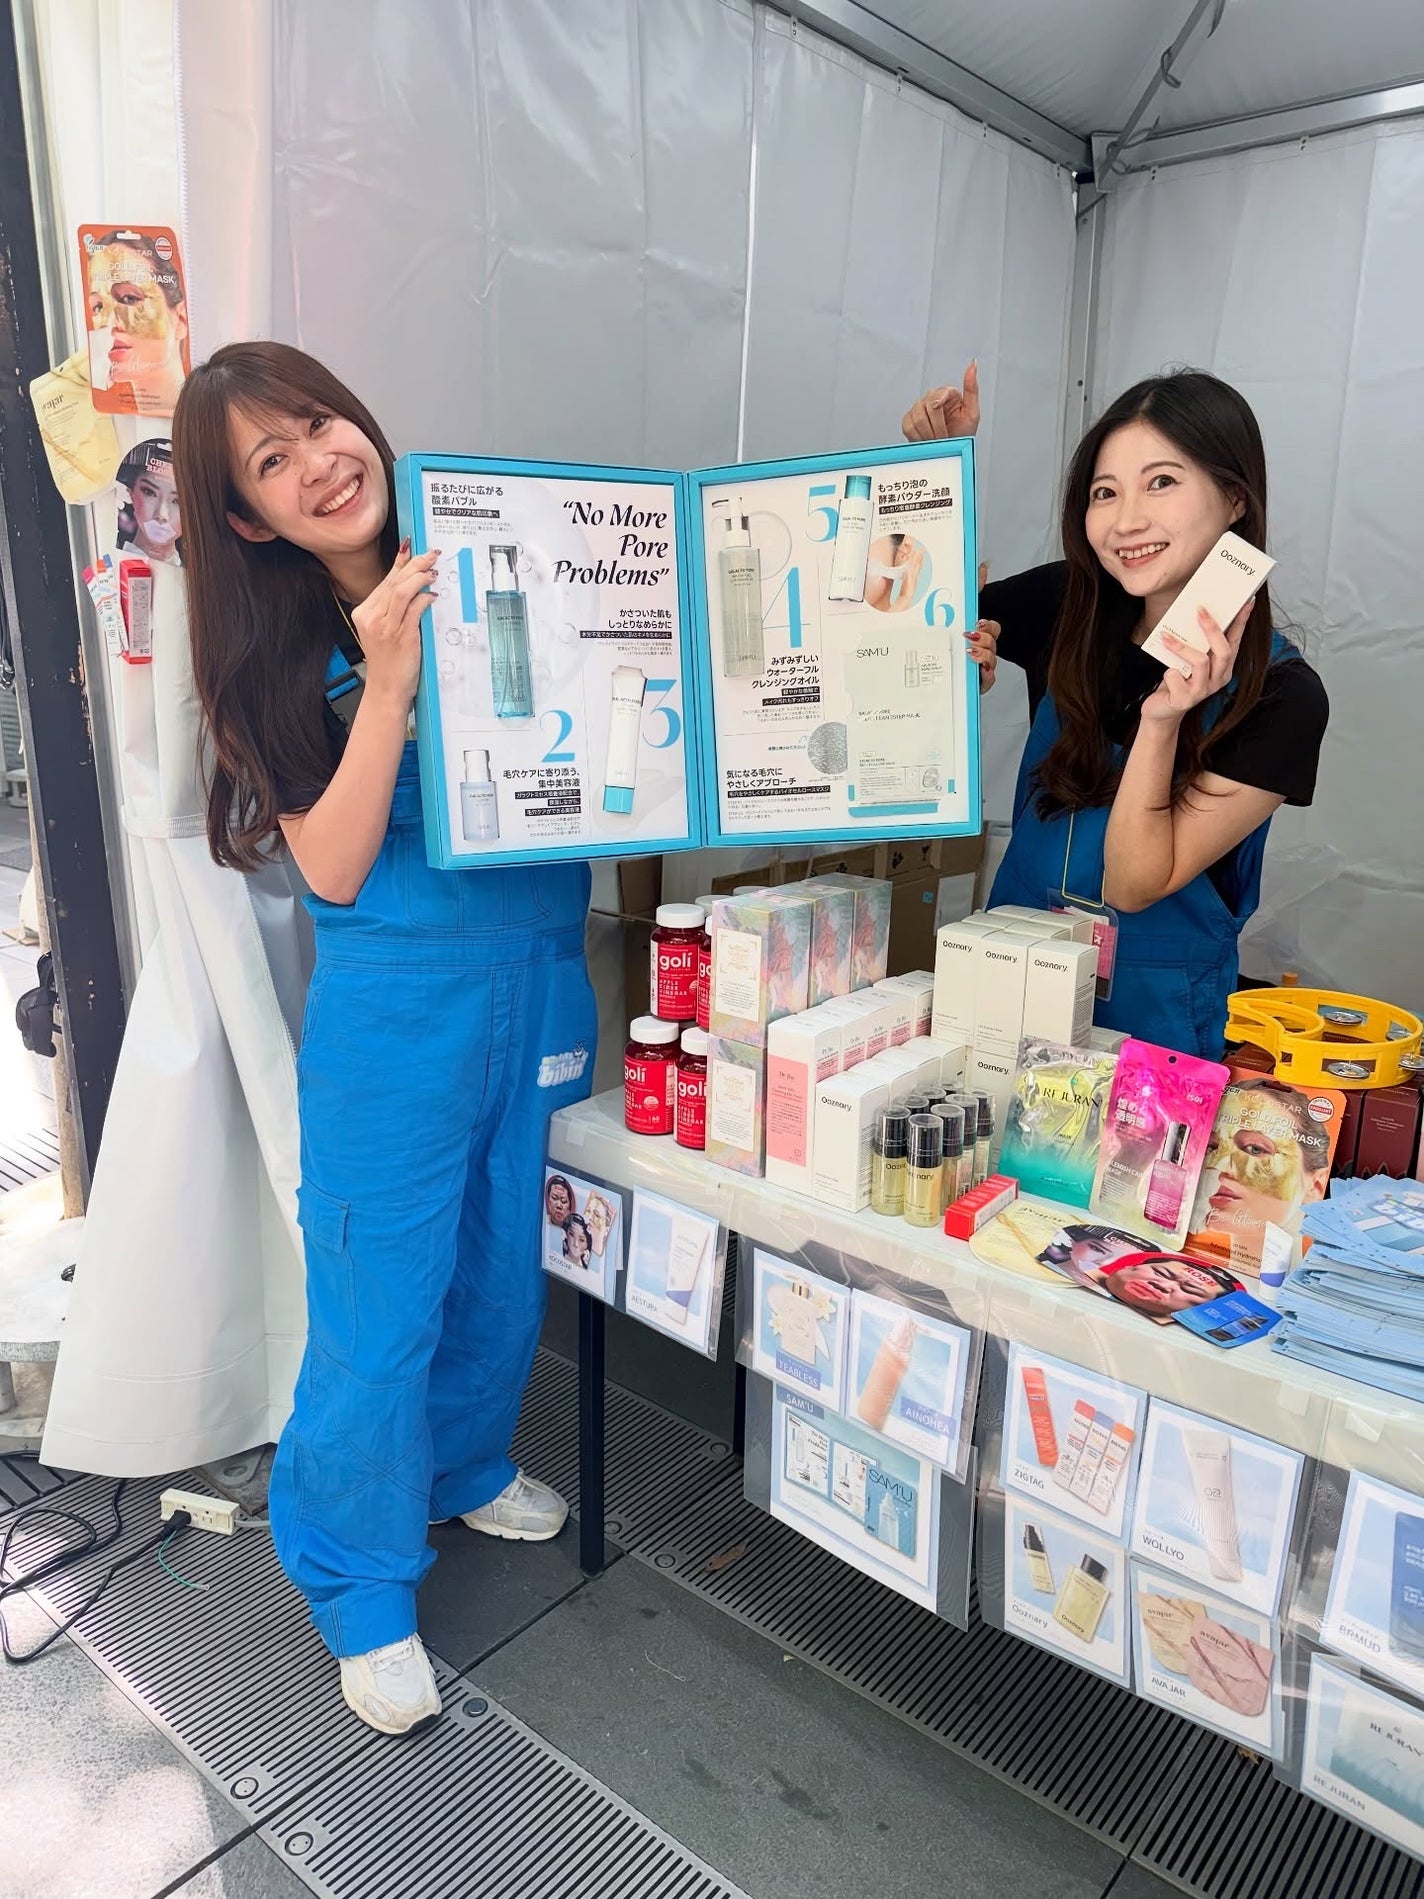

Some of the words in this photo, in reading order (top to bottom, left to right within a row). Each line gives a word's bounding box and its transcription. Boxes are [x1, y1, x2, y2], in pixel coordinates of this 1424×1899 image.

[149, 274, 175, 285] MASK
[431, 482, 503, 496] 振るたびに広がる
[878, 479, 928, 493] もっちり泡の
[431, 494, 477, 506] 酸素バブル
[609, 503, 668, 529] More
[805, 484, 839, 542] 5
[619, 533, 669, 558] Pore
[446, 547, 478, 623] 1
[619, 608, 672, 619] かさついた肌も
[761, 567, 811, 648] 4
[924, 588, 955, 628] 6
[608, 619, 672, 630] しっとりなめらかに
[771, 654, 819, 666] みずみずしい
[766, 665, 819, 677] ウォーターフル
[752, 676, 820, 689] クレンジングオイル
[642, 679, 681, 748] 3
[540, 710, 575, 762] 2
[538, 778, 580, 788] 集中美容液
[726, 768, 783, 779] 気になる毛穴に
[726, 777, 797, 789] やさしくアプローチ
[1289, 1131, 1321, 1147] MASK
[1184, 1266, 1216, 1287] ROSE
[779, 1360, 818, 1388] TEABLESS
[786, 1393, 814, 1413] SAM'U
[868, 1468, 913, 1502] SAM'U
[1014, 1468, 1045, 1489] ZIGTAG
[1142, 1534, 1185, 1561] WOLLYO
[1011, 1603, 1049, 1628] Ooznary
[1151, 1677, 1187, 1698] AVAJAR
[1313, 1774, 1366, 1811] REJURAN
